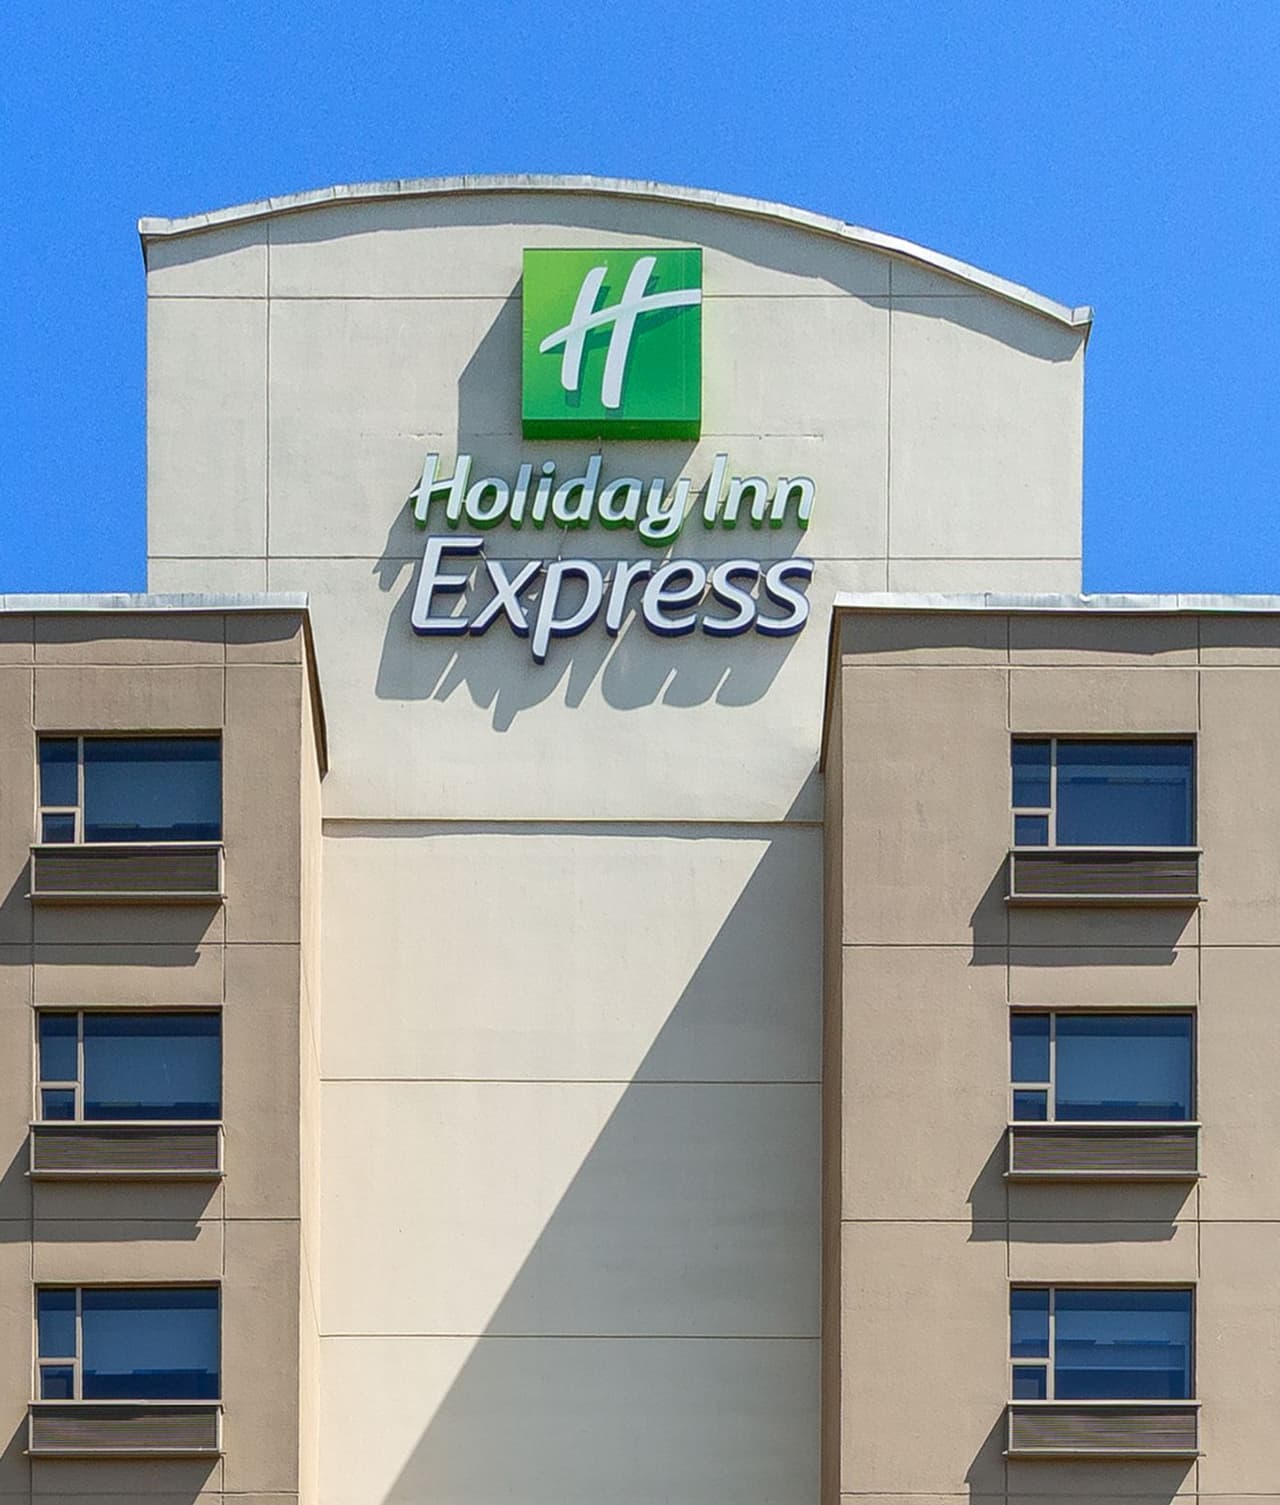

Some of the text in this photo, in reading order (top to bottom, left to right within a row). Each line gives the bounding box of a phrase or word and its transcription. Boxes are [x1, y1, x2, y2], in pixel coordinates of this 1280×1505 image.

[410, 453, 816, 547] Holiday Inn
[411, 535, 815, 665] Express
